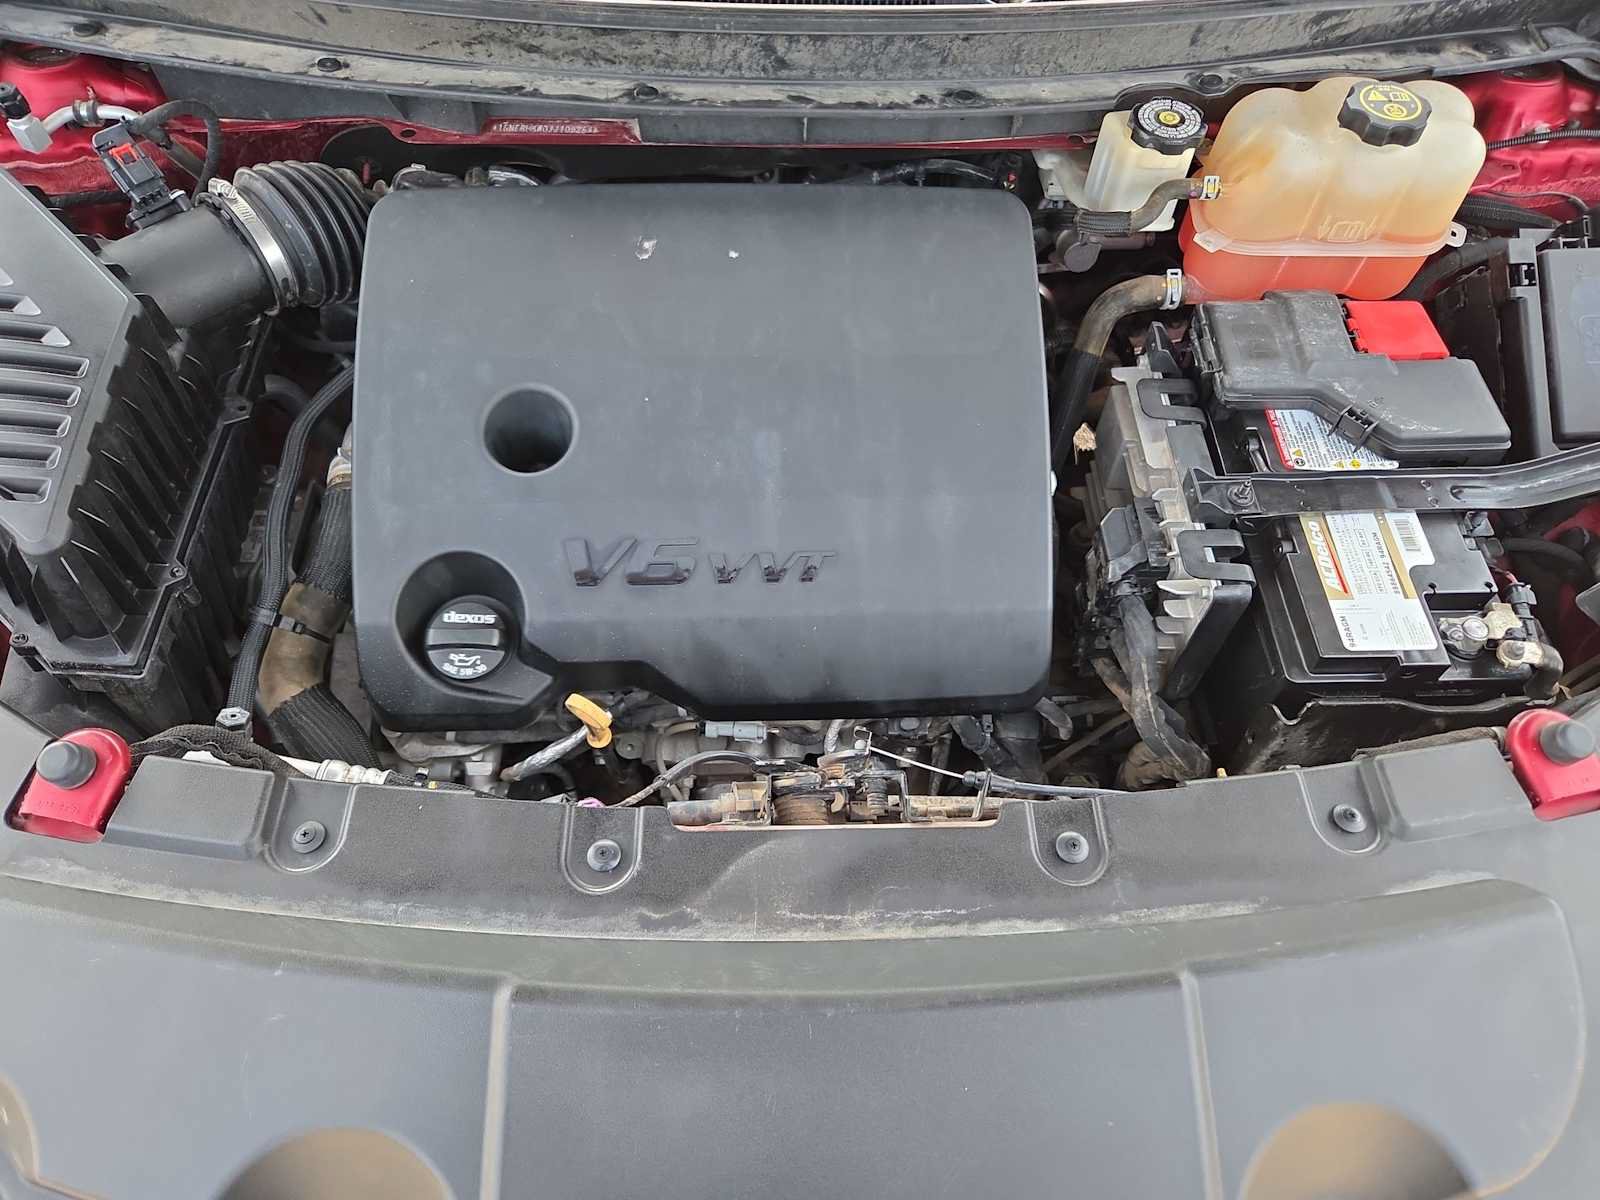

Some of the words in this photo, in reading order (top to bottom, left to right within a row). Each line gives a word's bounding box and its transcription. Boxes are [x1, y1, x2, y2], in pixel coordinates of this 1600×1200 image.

[562, 537, 700, 587] V6
[707, 550, 838, 584] VVT
[443, 610, 497, 624] dexos
[1339, 615, 1356, 648] 94RAGM
[442, 662, 459, 675] SAE
[459, 664, 488, 676] 5W-30
